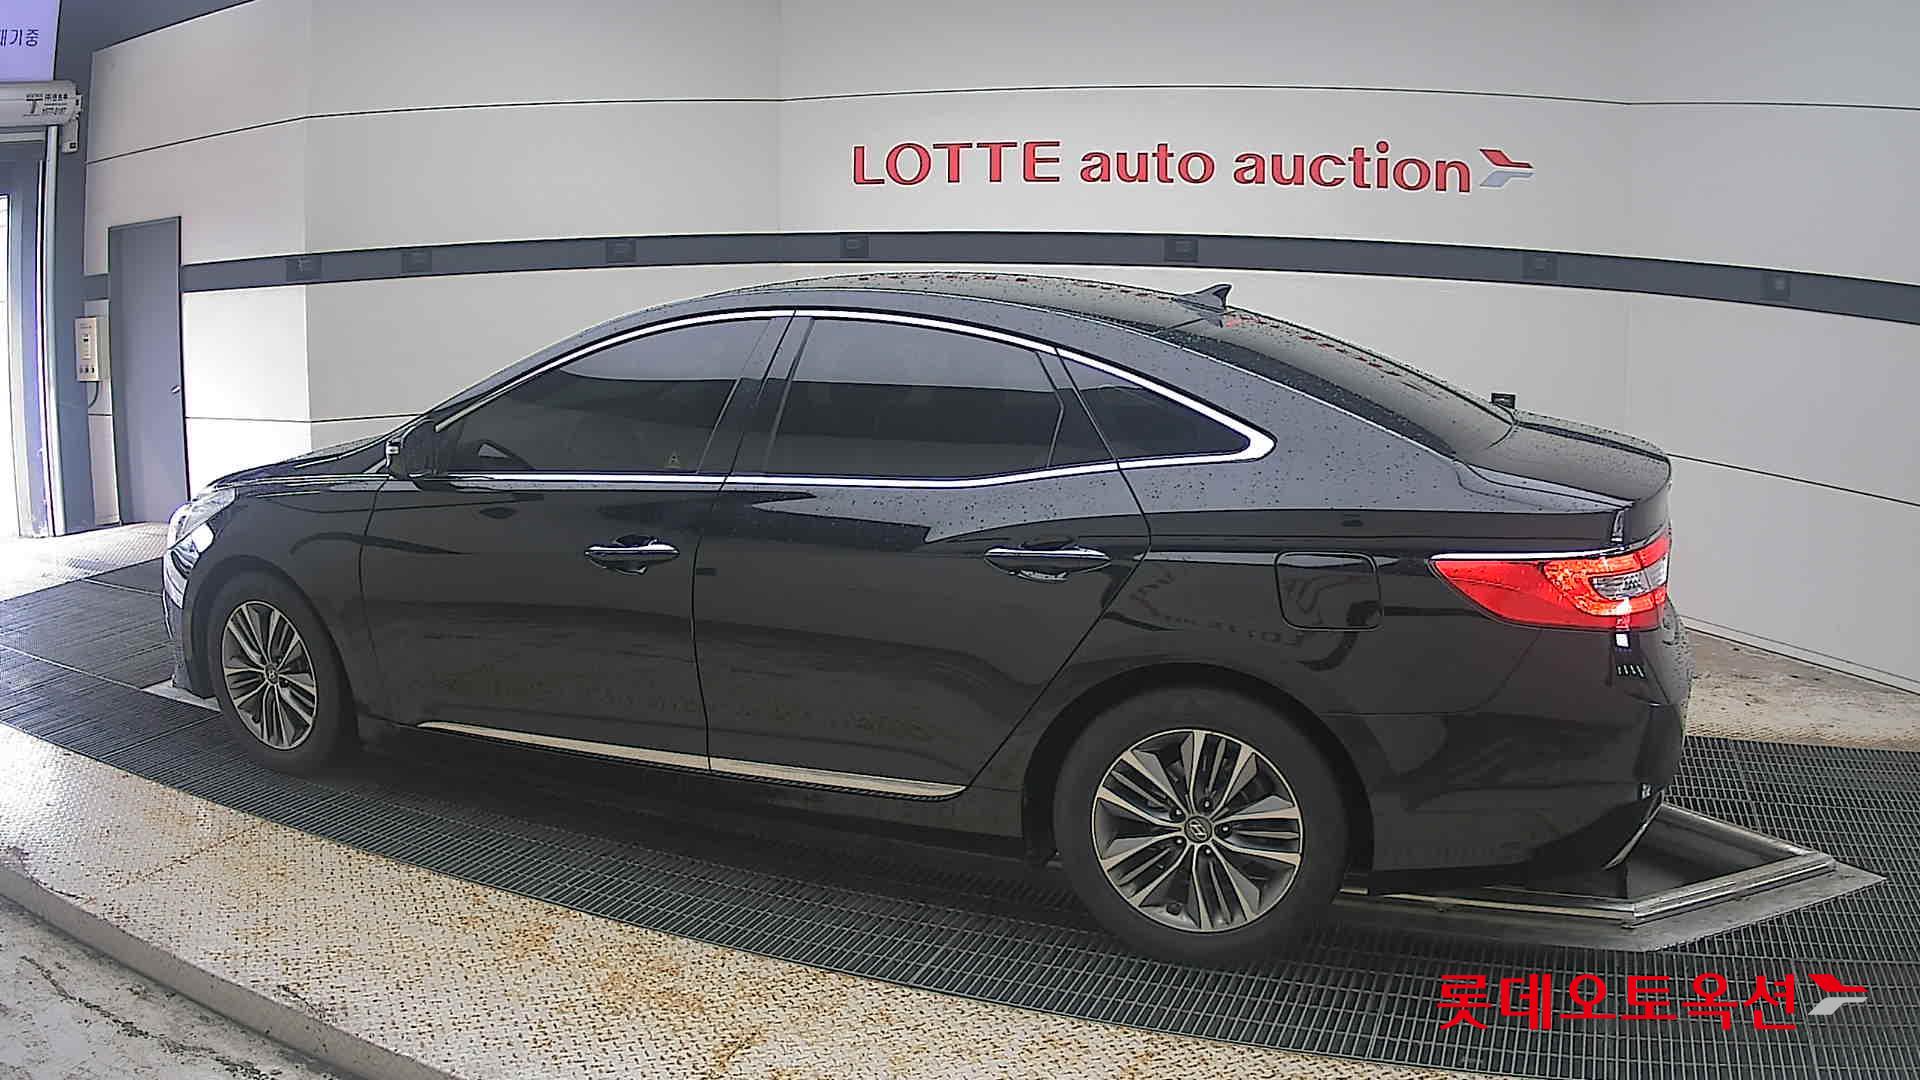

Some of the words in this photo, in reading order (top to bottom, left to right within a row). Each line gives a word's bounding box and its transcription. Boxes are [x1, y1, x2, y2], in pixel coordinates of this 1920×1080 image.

[853, 140, 1060, 186] LOTTE
[1080, 142, 1216, 184] auto
[1233, 141, 1472, 193] auction
